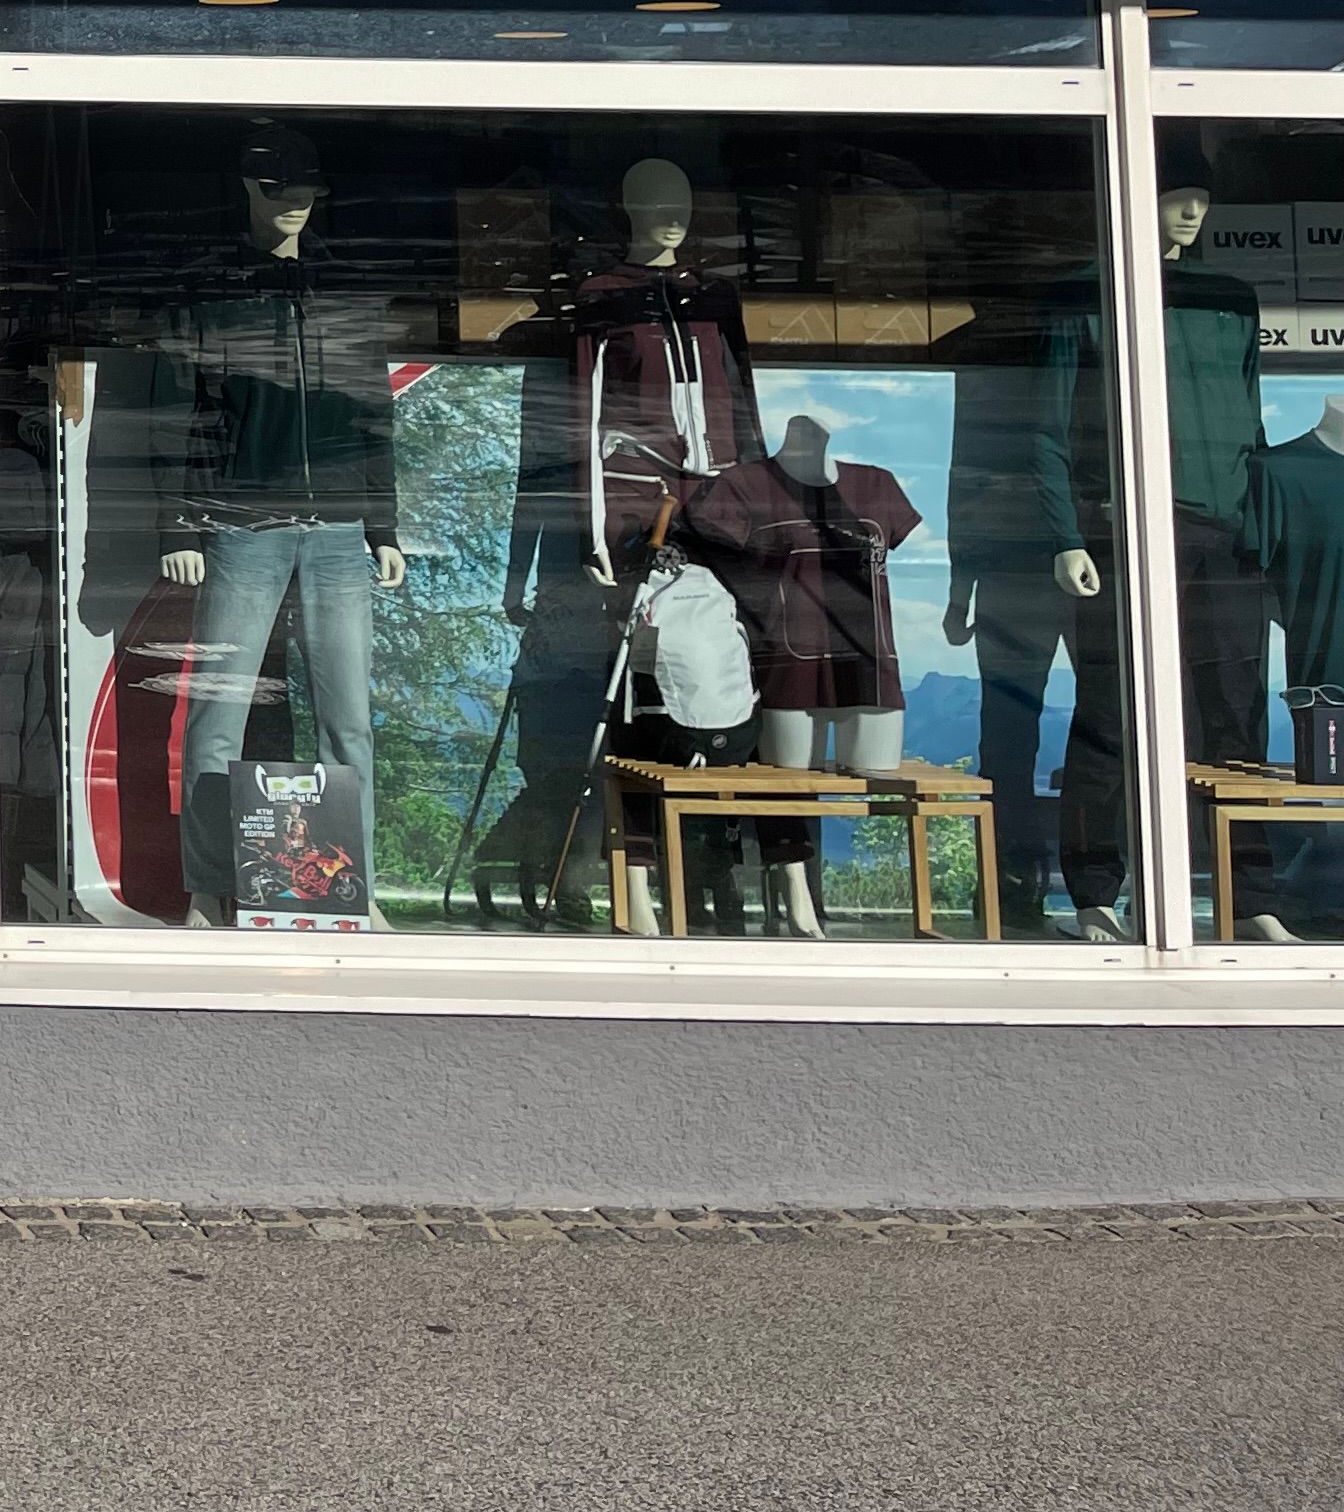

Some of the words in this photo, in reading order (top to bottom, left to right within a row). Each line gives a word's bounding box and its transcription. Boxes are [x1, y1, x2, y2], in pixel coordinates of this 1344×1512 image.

[1213, 230, 1282, 248] uvex
[1307, 228, 1344, 245] uv
[1258, 328, 1289, 346] ex
[243, 815, 275, 823] LIMITED
[239, 822, 263, 830] MOTO
[263, 823, 276, 831] GP
[244, 830, 276, 838] EDITION
